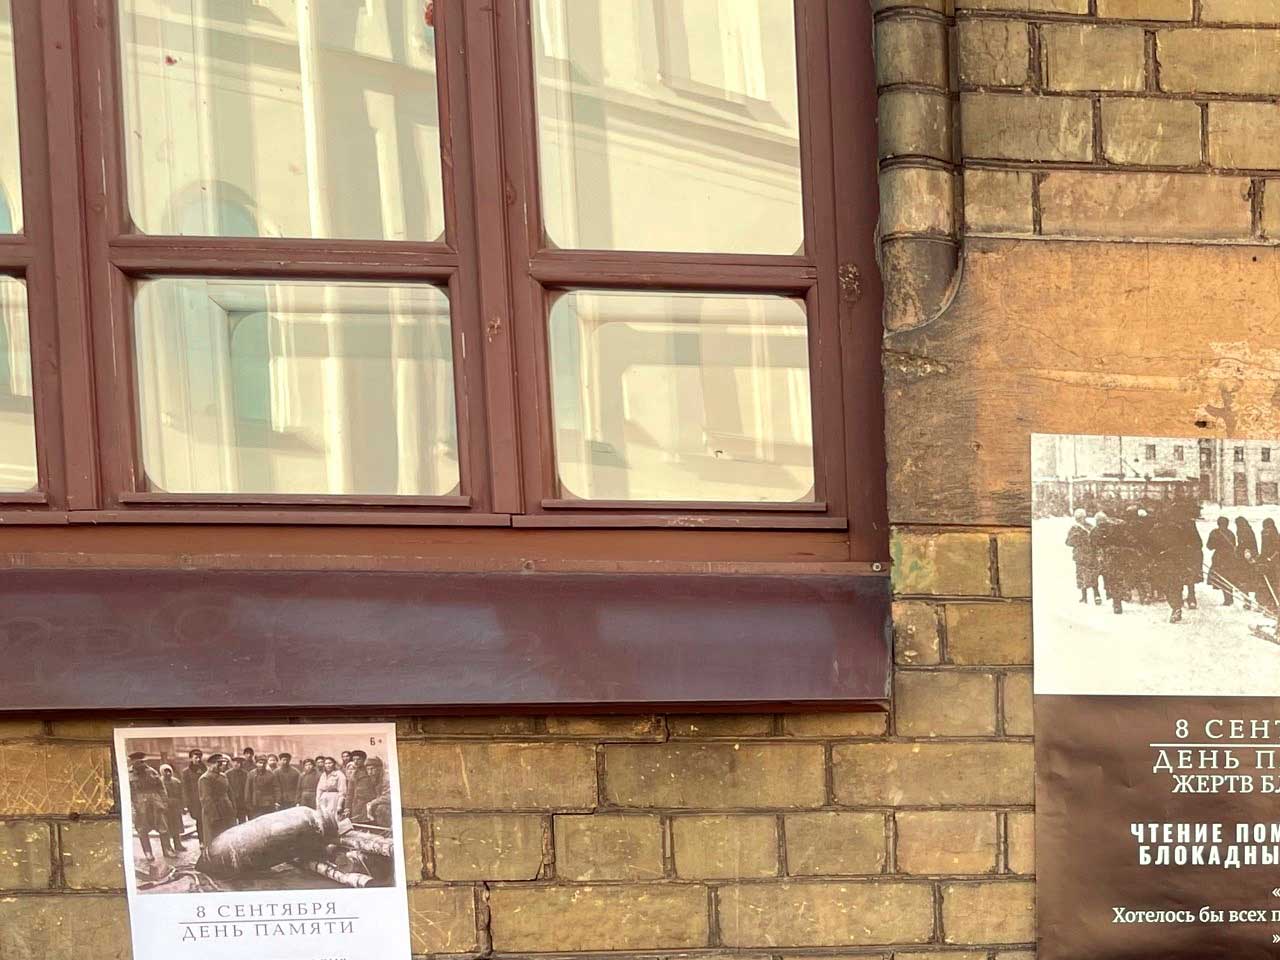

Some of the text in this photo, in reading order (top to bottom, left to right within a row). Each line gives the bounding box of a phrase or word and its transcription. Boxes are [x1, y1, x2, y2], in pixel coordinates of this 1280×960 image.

[1176, 720, 1189, 738] 8
[1153, 750, 1240, 773] ДЕНЬ
[1172, 774, 1254, 793] ЖЕРТВ
[1130, 823, 1223, 843] ЧТЕНИЕ
[197, 902, 337, 917] 8 СЕНТЯБРЯ
[1112, 906, 1195, 924] Хотелось
[1199, 906, 1225, 923] бы
[1229, 908, 1266, 923] всех
[182, 921, 354, 941] ДЕНЬ ПАМЯТИ
